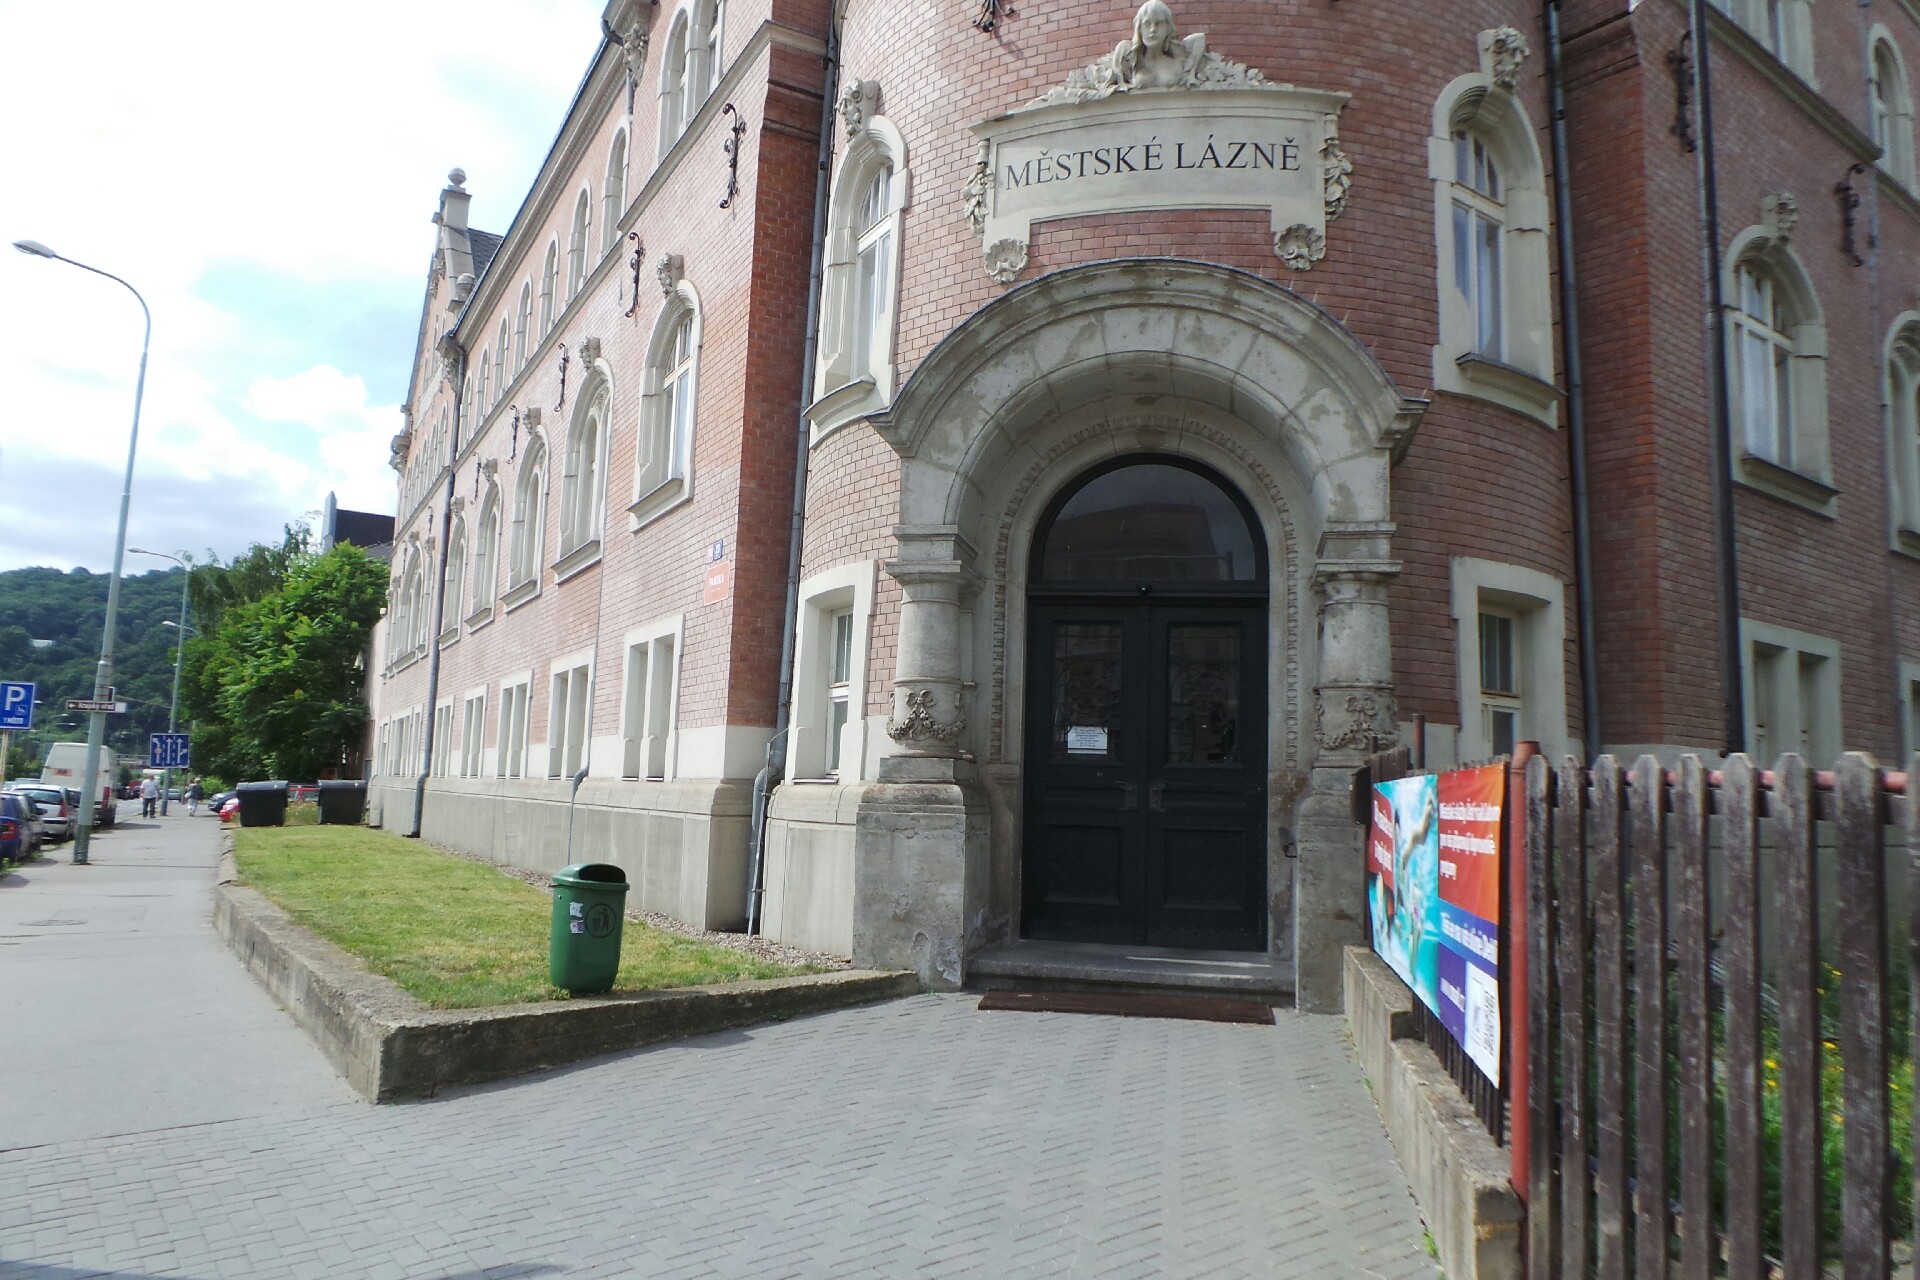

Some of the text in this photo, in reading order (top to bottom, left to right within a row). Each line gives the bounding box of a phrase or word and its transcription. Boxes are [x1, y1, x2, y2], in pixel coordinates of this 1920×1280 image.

[1005, 134, 1301, 190] MĚSTSKÉ LÁZNĚ
[5, 686, 26, 711] P
